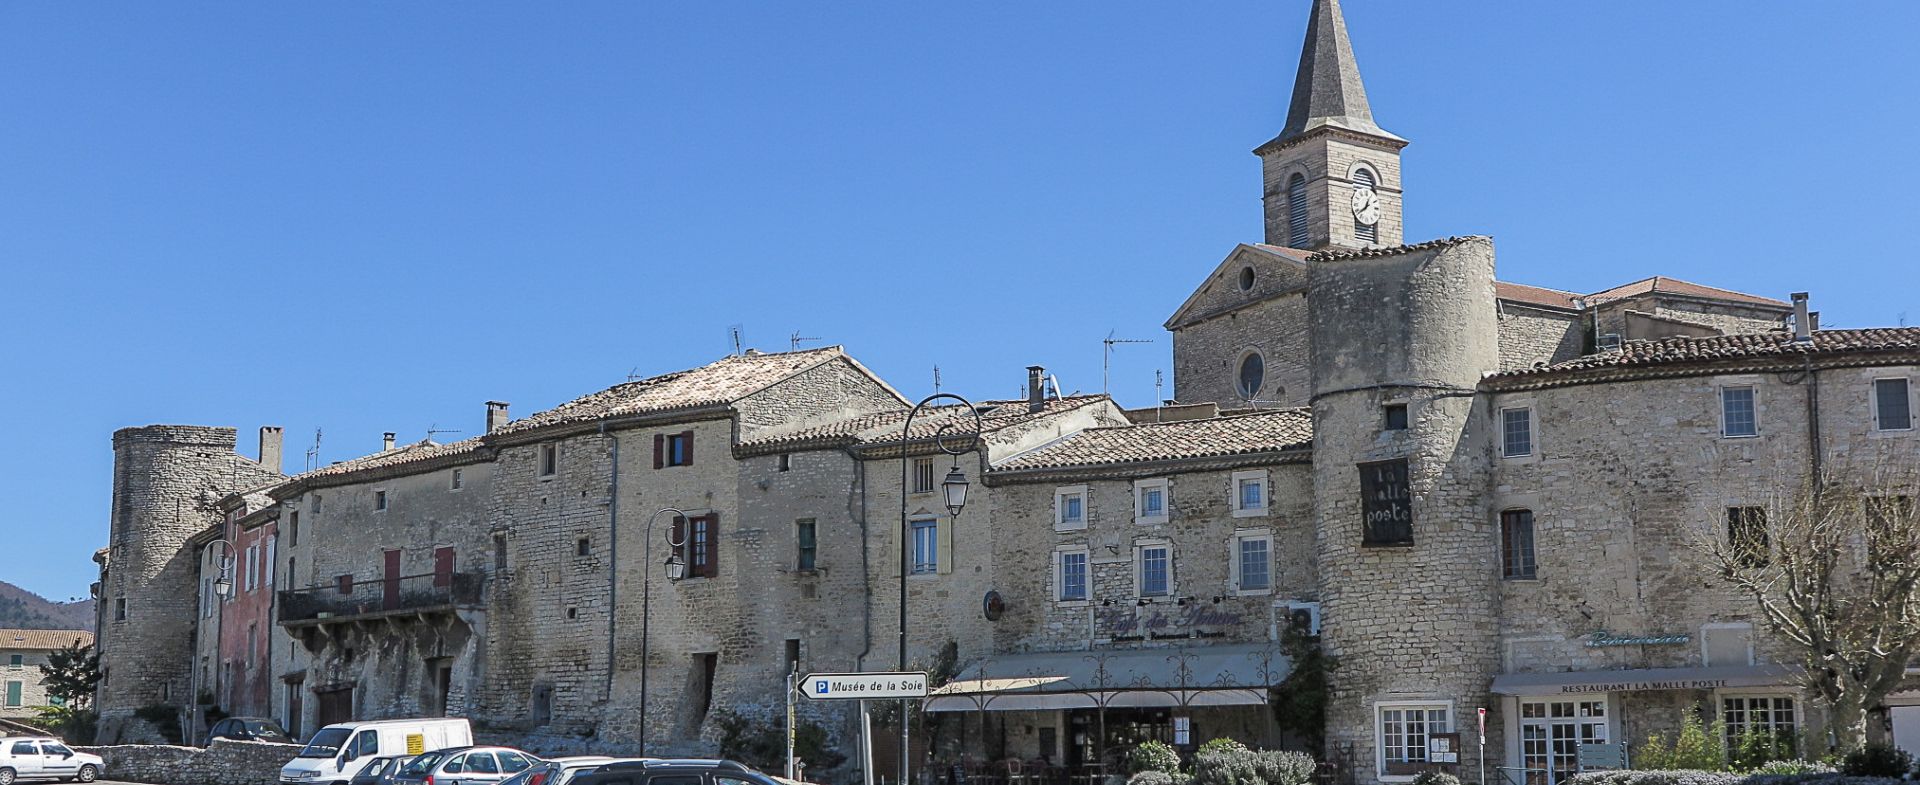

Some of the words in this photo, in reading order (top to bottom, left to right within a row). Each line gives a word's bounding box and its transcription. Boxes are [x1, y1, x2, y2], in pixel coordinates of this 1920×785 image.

[1366, 502, 1409, 529] poste
[831, 681, 865, 692] Musée
[870, 681, 882, 691] de
[887, 681, 896, 690] la
[900, 680, 923, 690] Soie
[1562, 683, 1631, 693] RESTAURANT
[1635, 682, 1649, 690] LA
[1652, 681, 1688, 690] MALLE
[1692, 679, 1728, 688] POSTE
